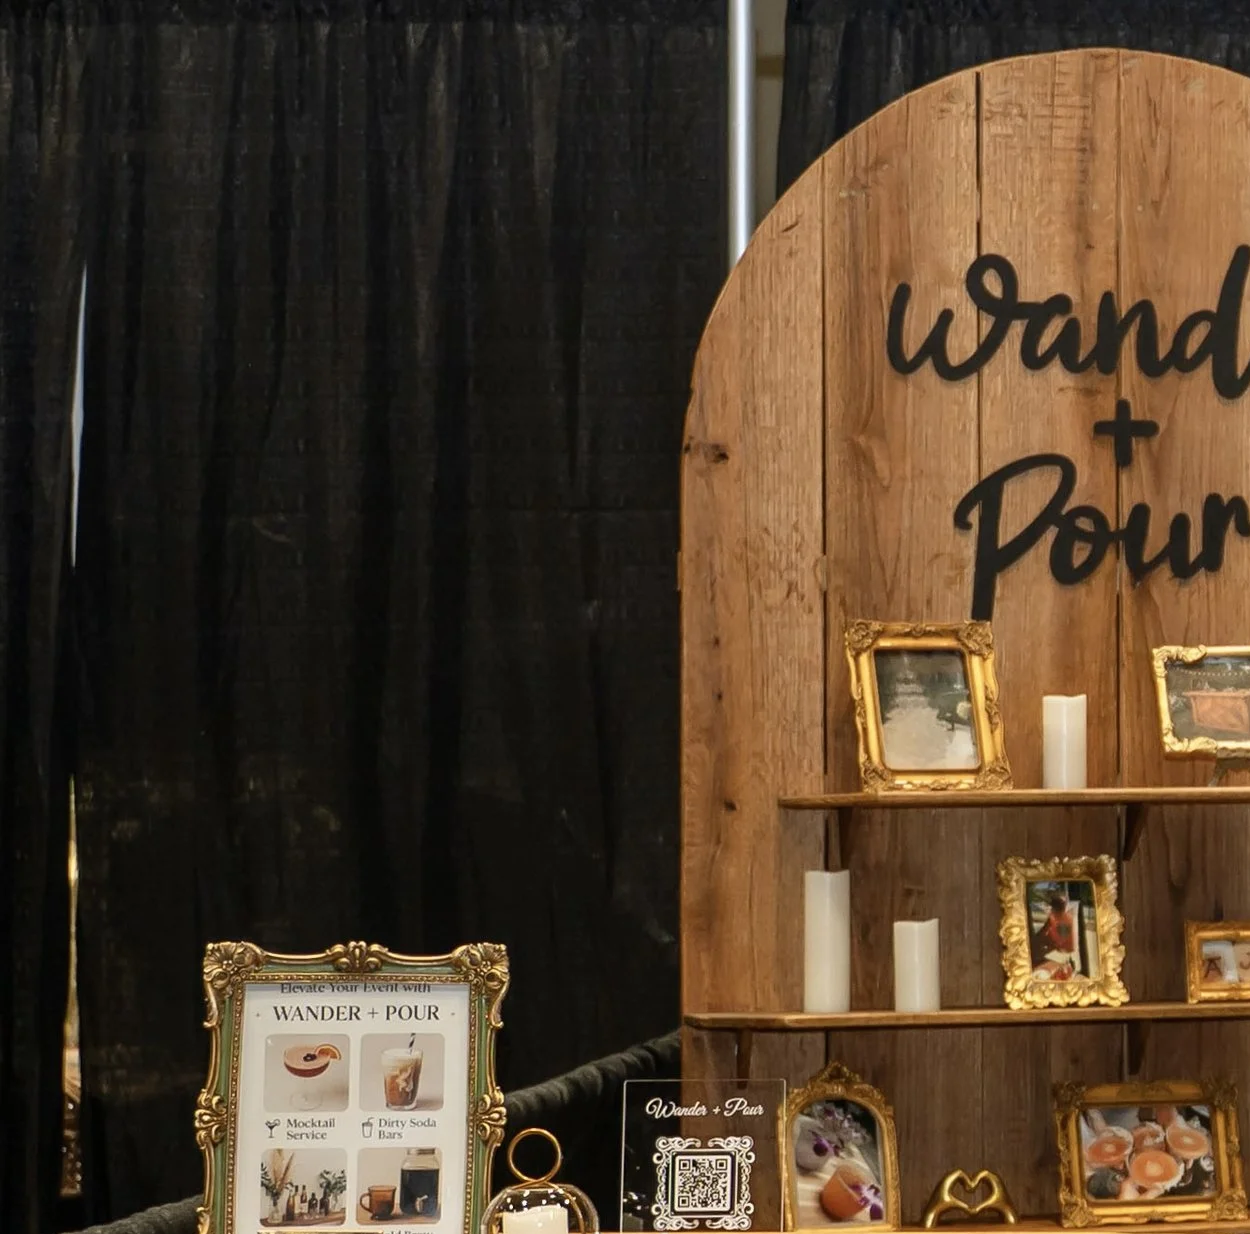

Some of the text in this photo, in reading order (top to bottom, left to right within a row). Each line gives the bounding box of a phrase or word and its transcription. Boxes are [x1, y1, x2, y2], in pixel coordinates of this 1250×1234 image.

[1093, 398, 1160, 467] +
[280, 982, 431, 994] Elevate Your Event with
[273, 1004, 440, 1021] WANDER + POUR
[645, 1097, 764, 1119] Wander + Pour
[286, 1118, 336, 1129] Mocktail
[378, 1118, 437, 1129] Dirty Soda
[286, 1130, 327, 1141] Service
[378, 1130, 403, 1140] Bars
